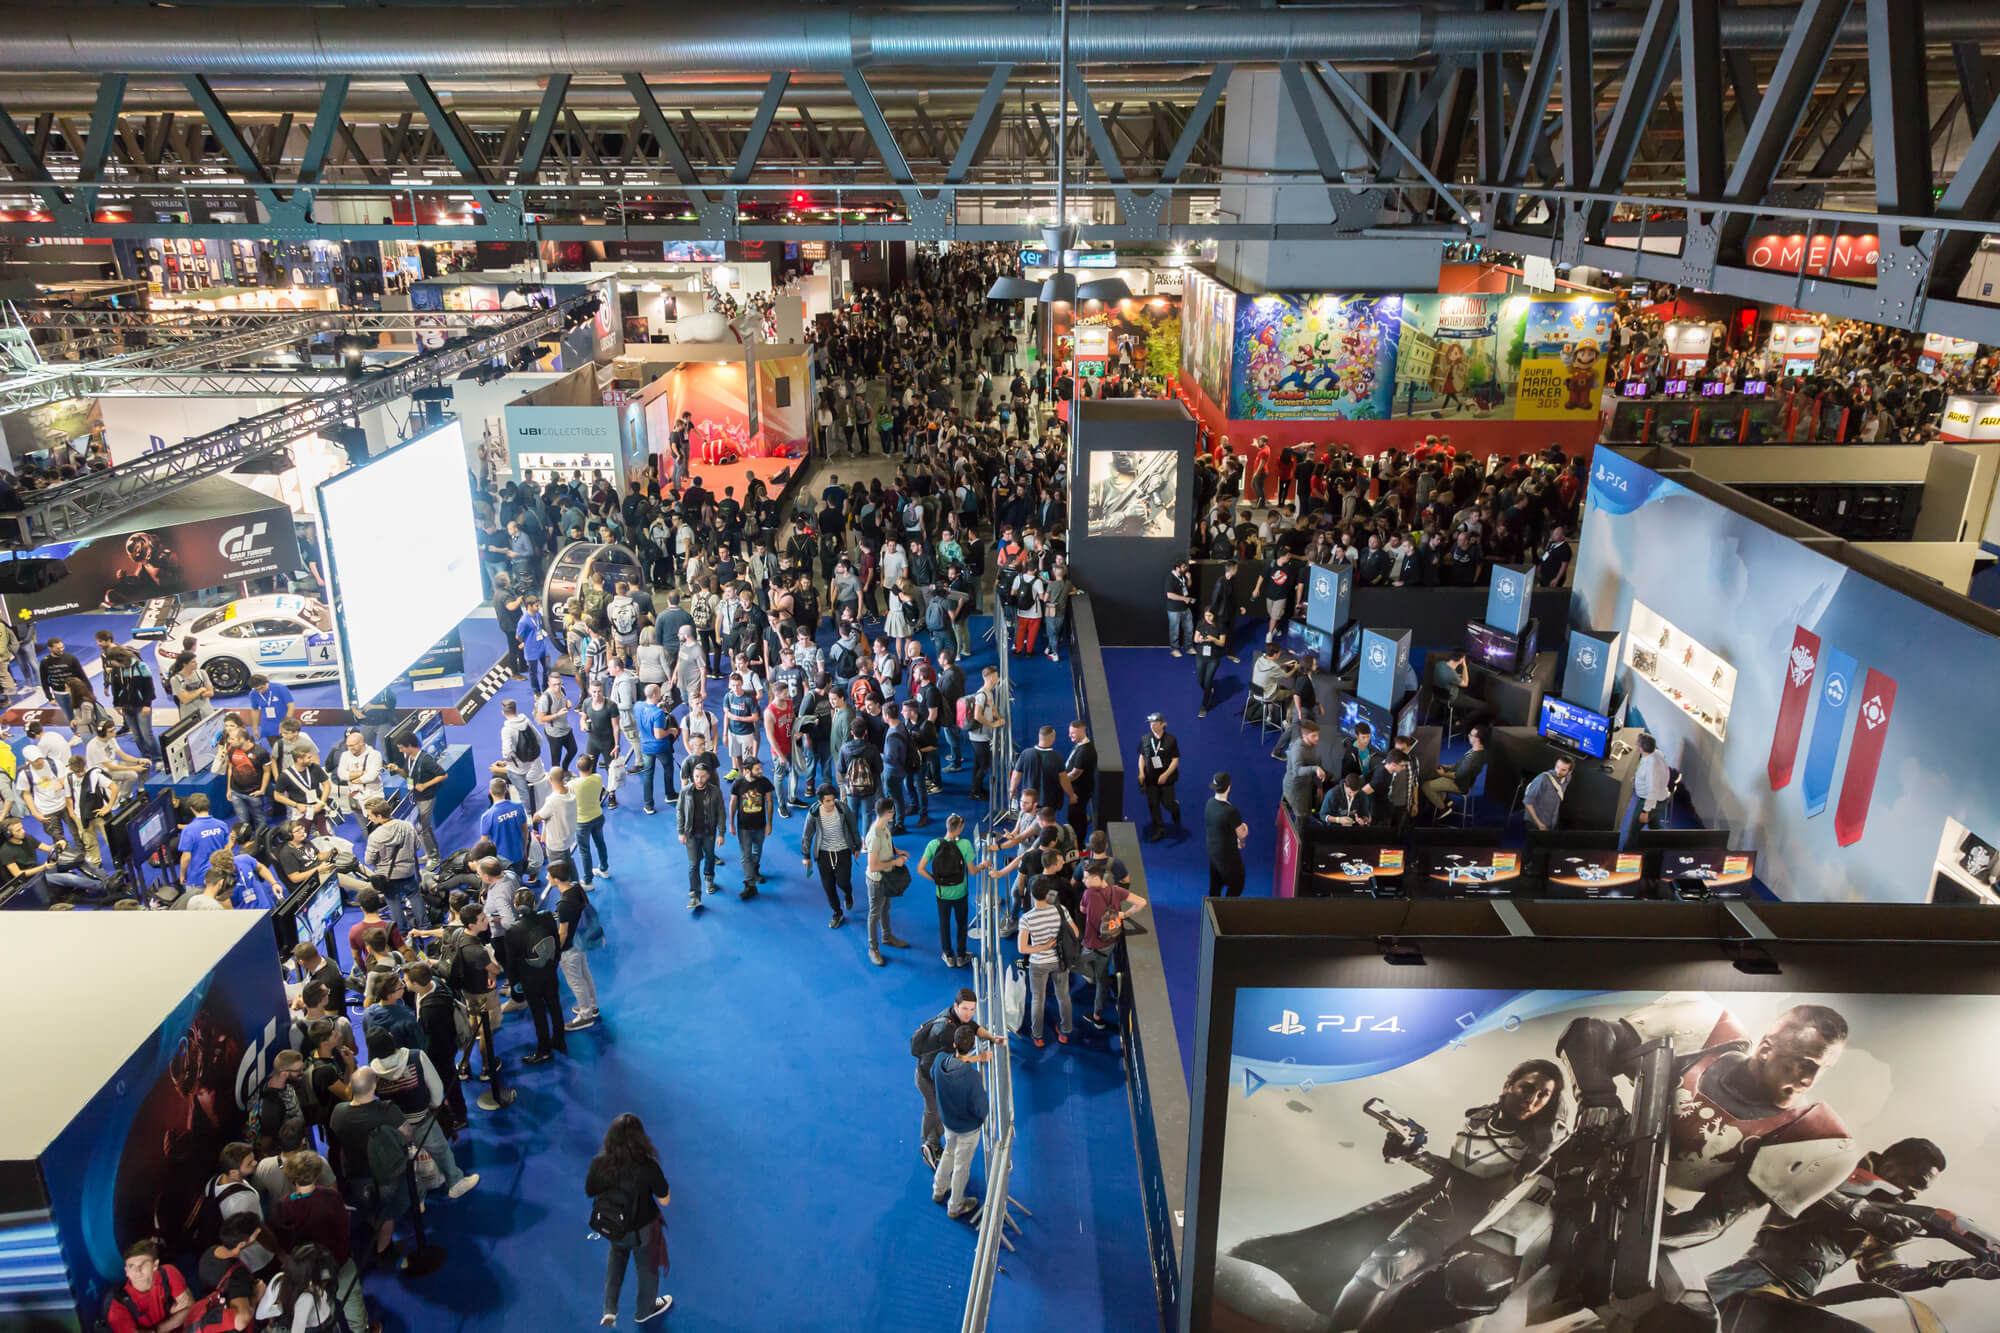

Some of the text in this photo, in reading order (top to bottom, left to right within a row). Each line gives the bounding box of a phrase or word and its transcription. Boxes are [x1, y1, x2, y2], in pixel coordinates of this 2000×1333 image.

[1752, 246, 1851, 268] OMEN
[1524, 368, 1553, 376] SUPER
[1522, 376, 1562, 387] MARIO
[1521, 387, 1562, 398] MAKER
[1536, 398, 1561, 409] 3DS
[1948, 411, 1970, 424] ARMS
[241, 558, 263, 567] SPORT
[320, 646, 329, 660] 4
[1316, 1015, 1401, 1033] PS4
